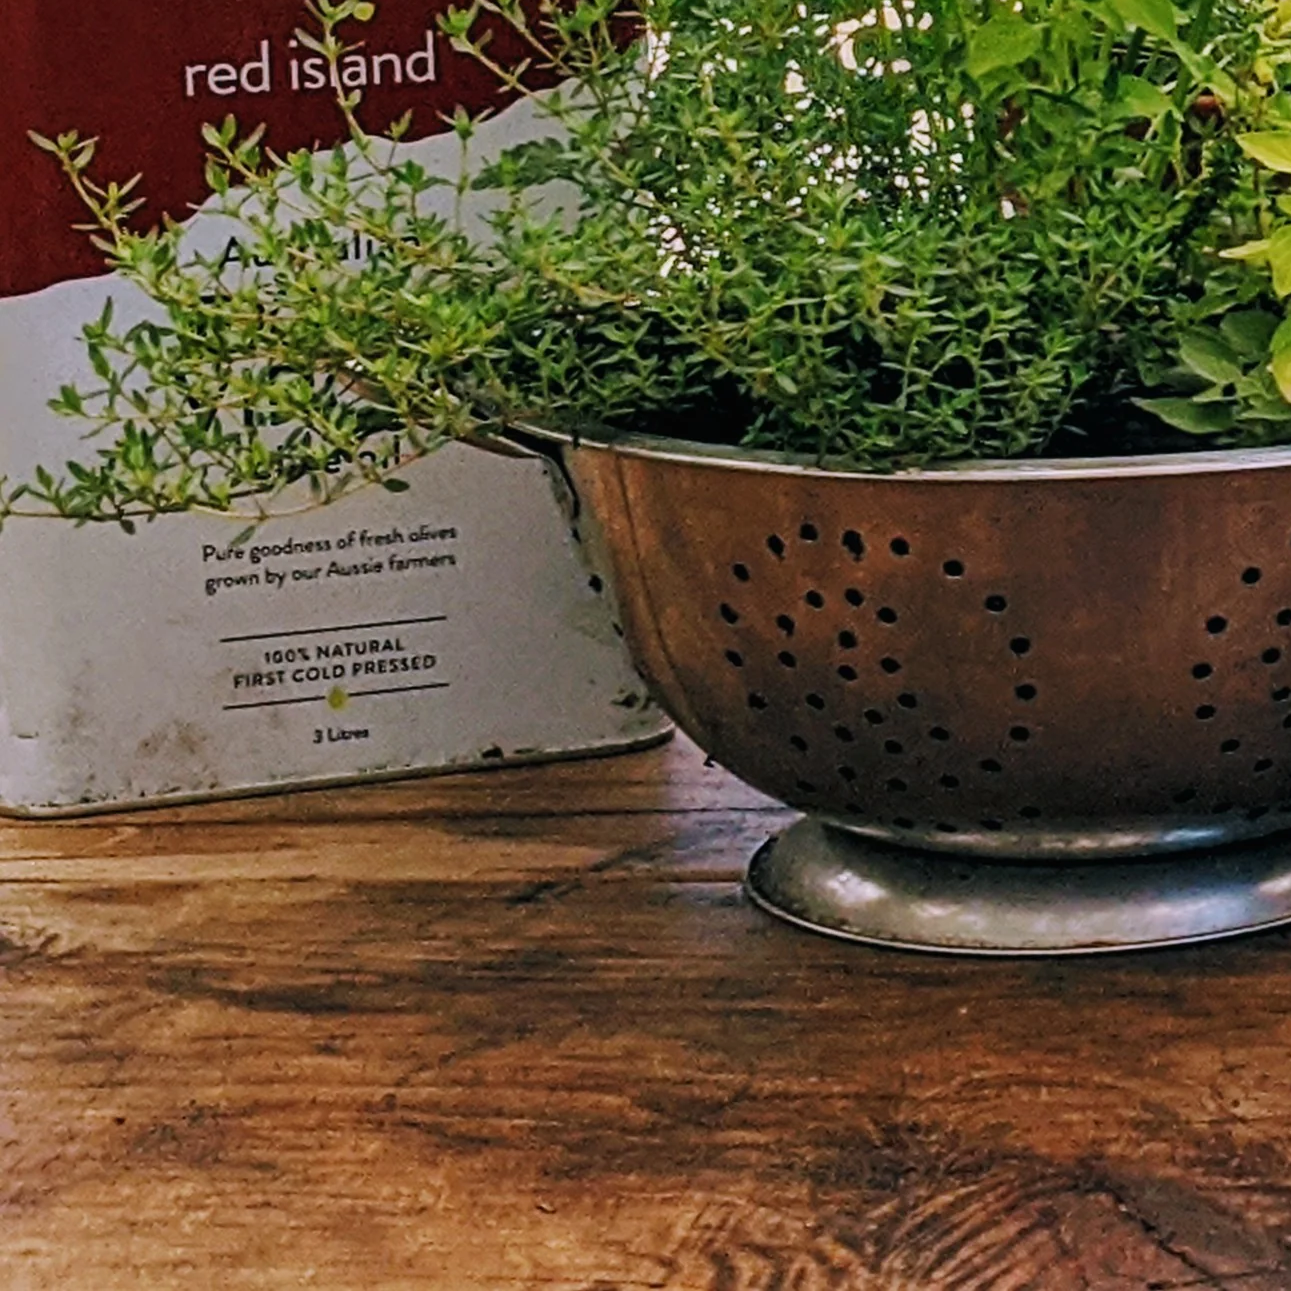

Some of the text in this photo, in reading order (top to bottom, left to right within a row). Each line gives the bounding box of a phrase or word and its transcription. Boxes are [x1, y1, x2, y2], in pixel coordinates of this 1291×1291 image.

[184, 39, 271, 97] red
[202, 524, 458, 564] Pure goodness of fresh olives
[204, 553, 457, 596] grown by our Aussie farmers
[264, 637, 406, 665] 100% NATURAL
[233, 654, 438, 689] FIRST COLD PRESSED
[313, 727, 370, 744] 3 Litres
